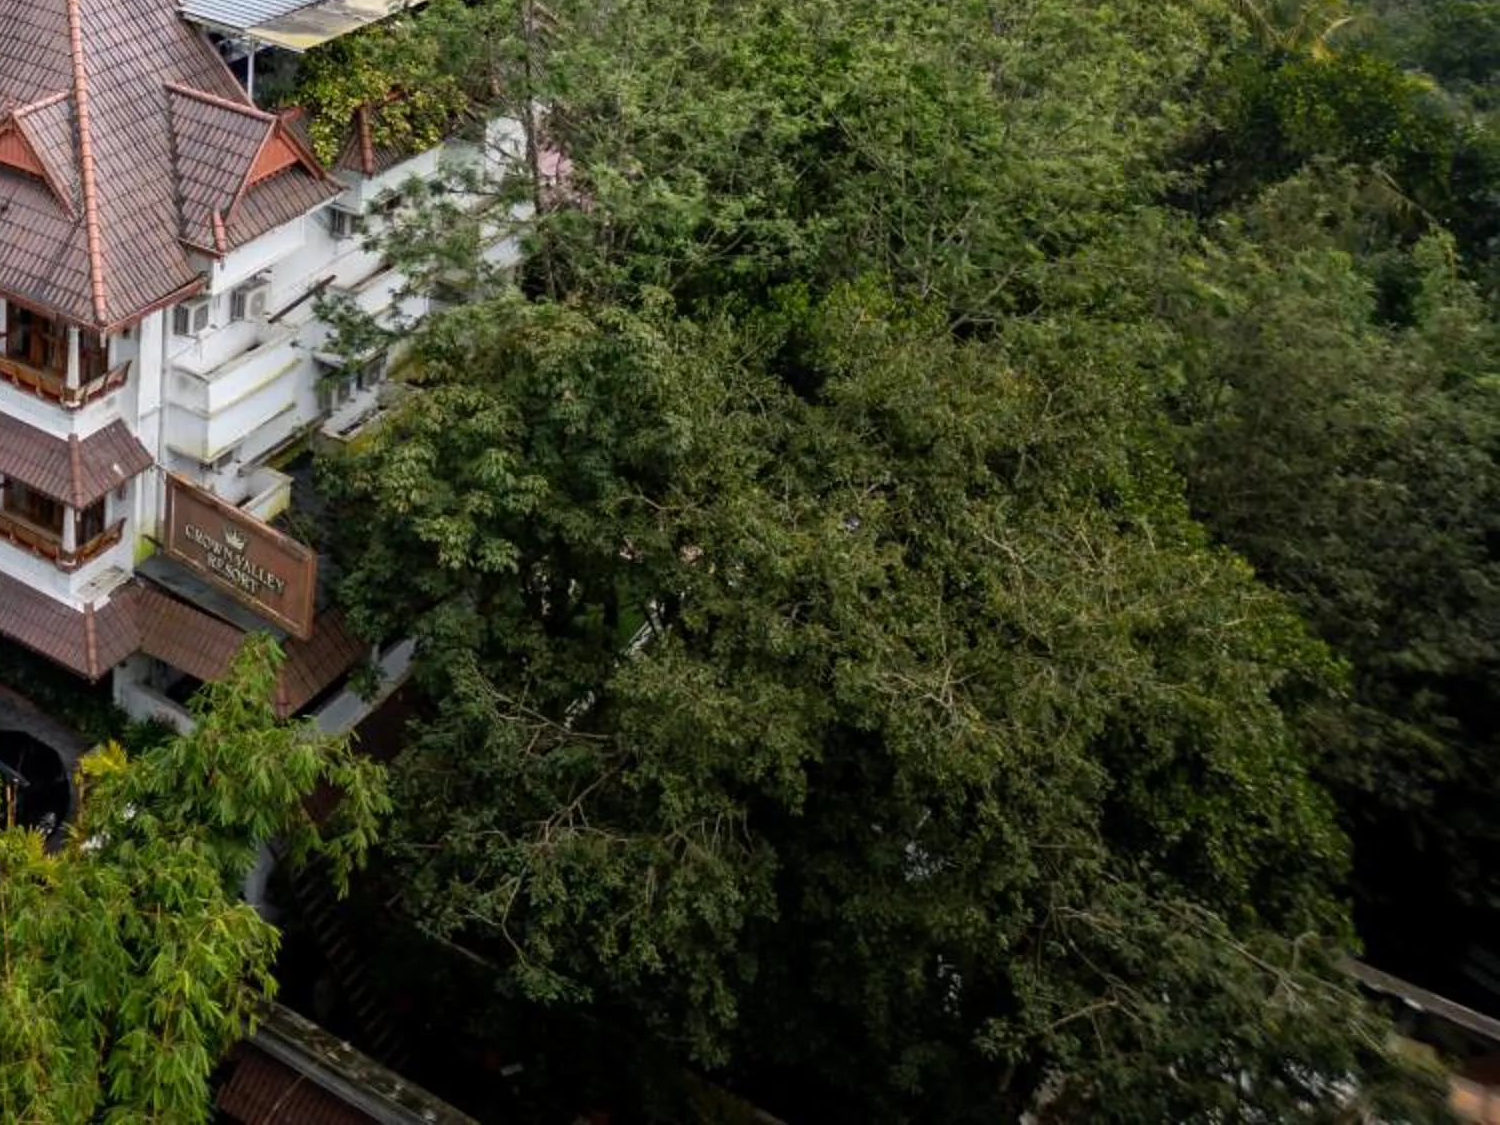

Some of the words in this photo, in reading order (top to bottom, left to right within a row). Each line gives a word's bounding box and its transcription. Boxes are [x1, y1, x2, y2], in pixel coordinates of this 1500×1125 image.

[185, 523, 233, 562] CROWN
[235, 554, 284, 592] VALLEY
[207, 552, 256, 593] RESORT
